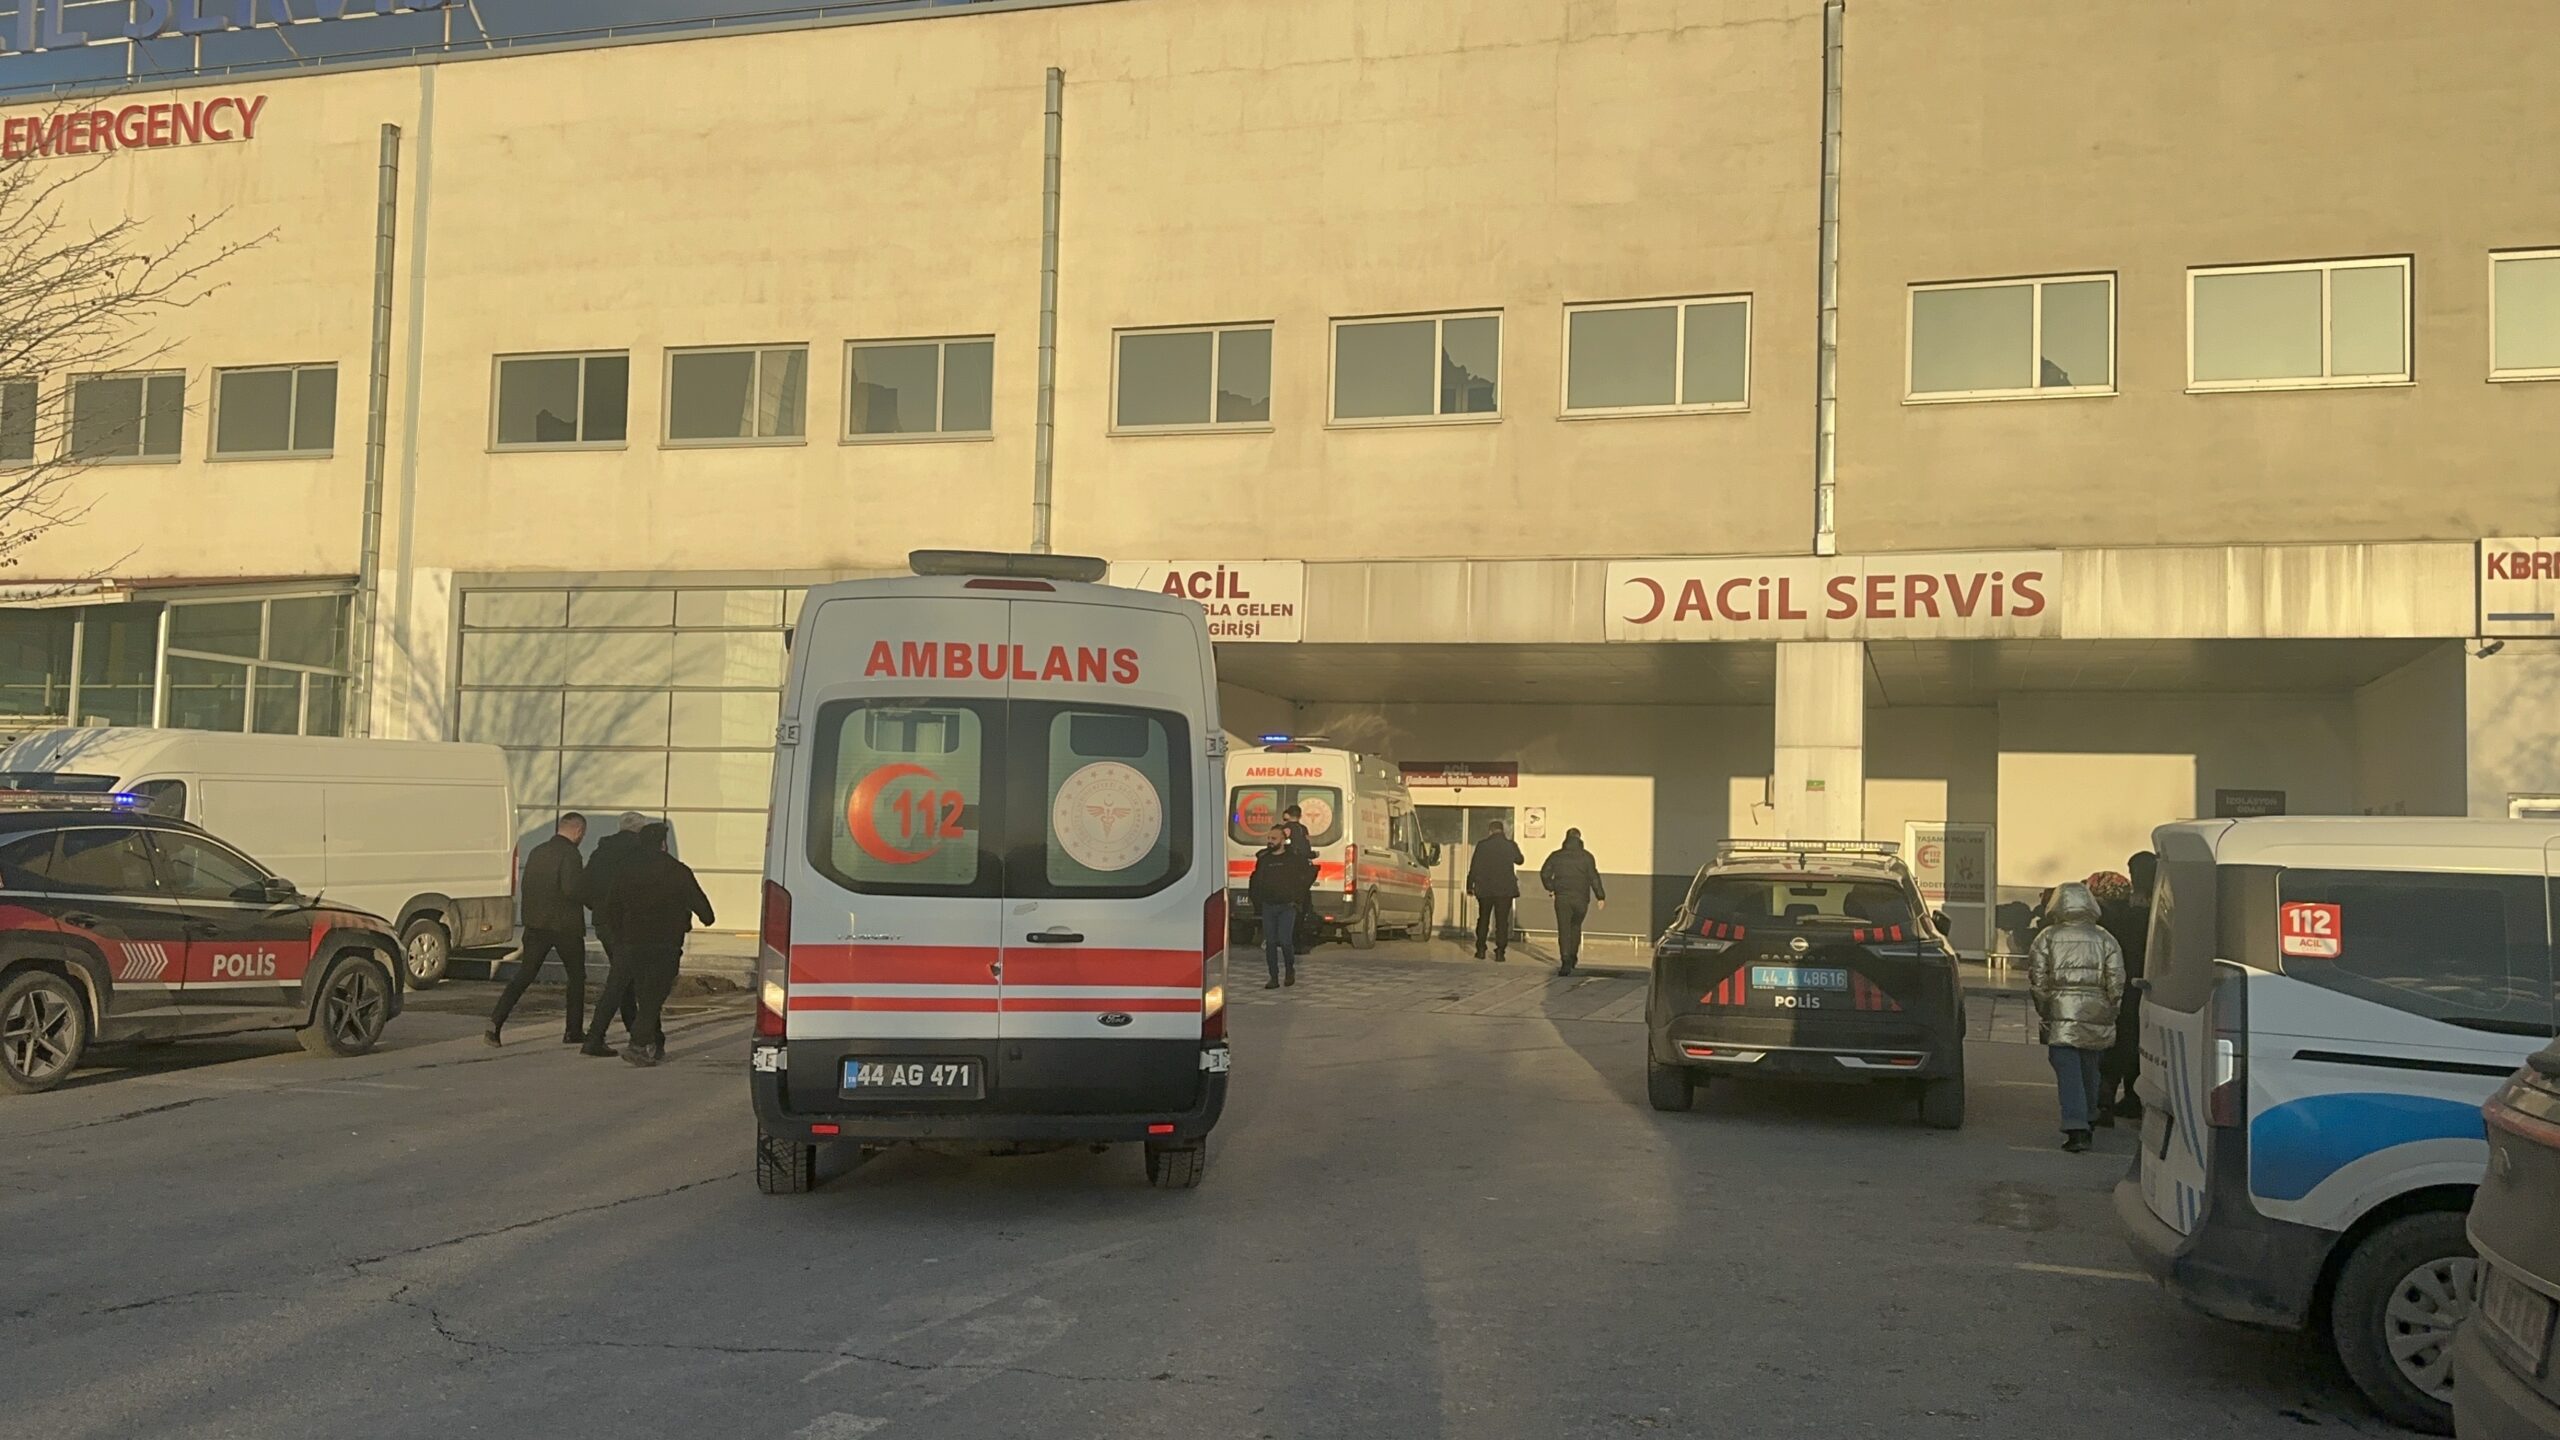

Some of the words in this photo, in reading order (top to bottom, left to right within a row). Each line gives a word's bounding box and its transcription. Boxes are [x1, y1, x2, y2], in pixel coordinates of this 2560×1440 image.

[1, 96, 267, 161] EMERGENCY
[1161, 564, 1250, 599] ACİL
[1236, 603, 1293, 616] GELEN
[1208, 620, 1260, 638] GİRİŞİ
[864, 640, 1140, 684] AMBULANS
[1246, 767, 1323, 777] AMBULANS
[892, 789, 965, 839] 112
[2289, 908, 2332, 935] 112
[211, 946, 277, 977] POLİS
[1762, 969, 1778, 986] 44
[1787, 970, 1795, 986] A
[1803, 971, 1845, 987] 48616
[1774, 994, 1820, 1008] POLİS
[857, 1064, 885, 1087] 44
[891, 1064, 924, 1087] AG
[930, 1064, 970, 1087] 471
